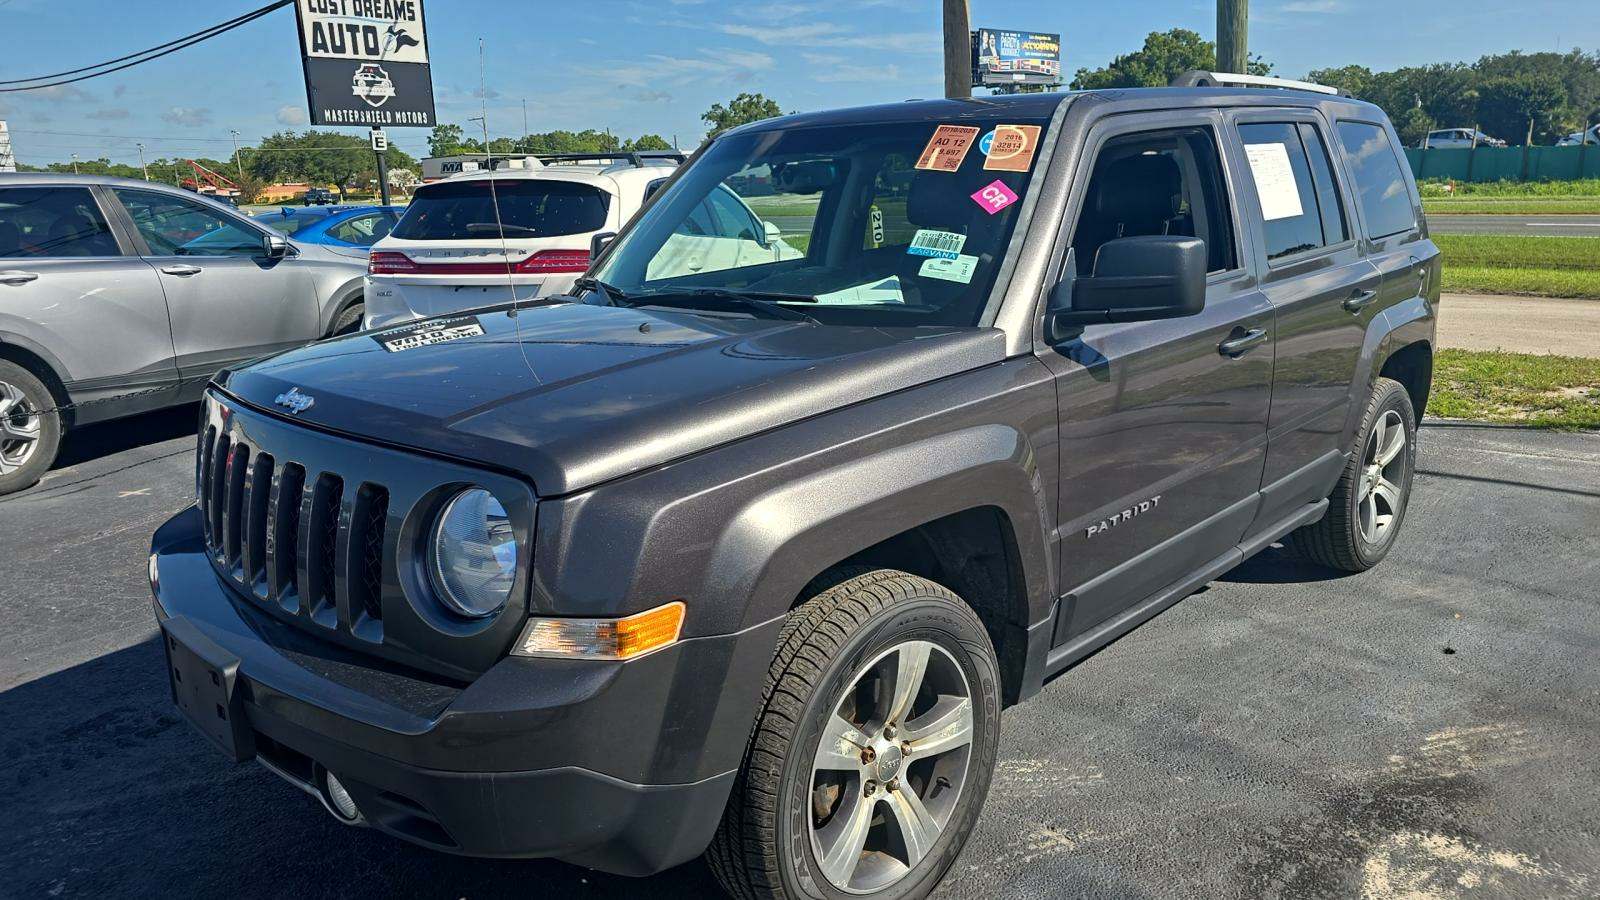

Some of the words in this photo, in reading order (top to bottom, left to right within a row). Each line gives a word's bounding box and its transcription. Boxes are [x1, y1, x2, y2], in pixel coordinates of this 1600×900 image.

[308, 0, 347, 15] LOST
[353, 0, 416, 21] DREAMS
[312, 21, 380, 56] AUTO
[324, 109, 392, 123] MASTERSHIELD
[395, 110, 428, 124] MOTORS
[375, 137, 385, 148] E
[953, 139, 966, 147] 12
[982, 186, 1009, 208] CR
[872, 213, 883, 241] 210
[909, 247, 956, 259] CARVANA
[1085, 495, 1161, 539] PATRIOT
